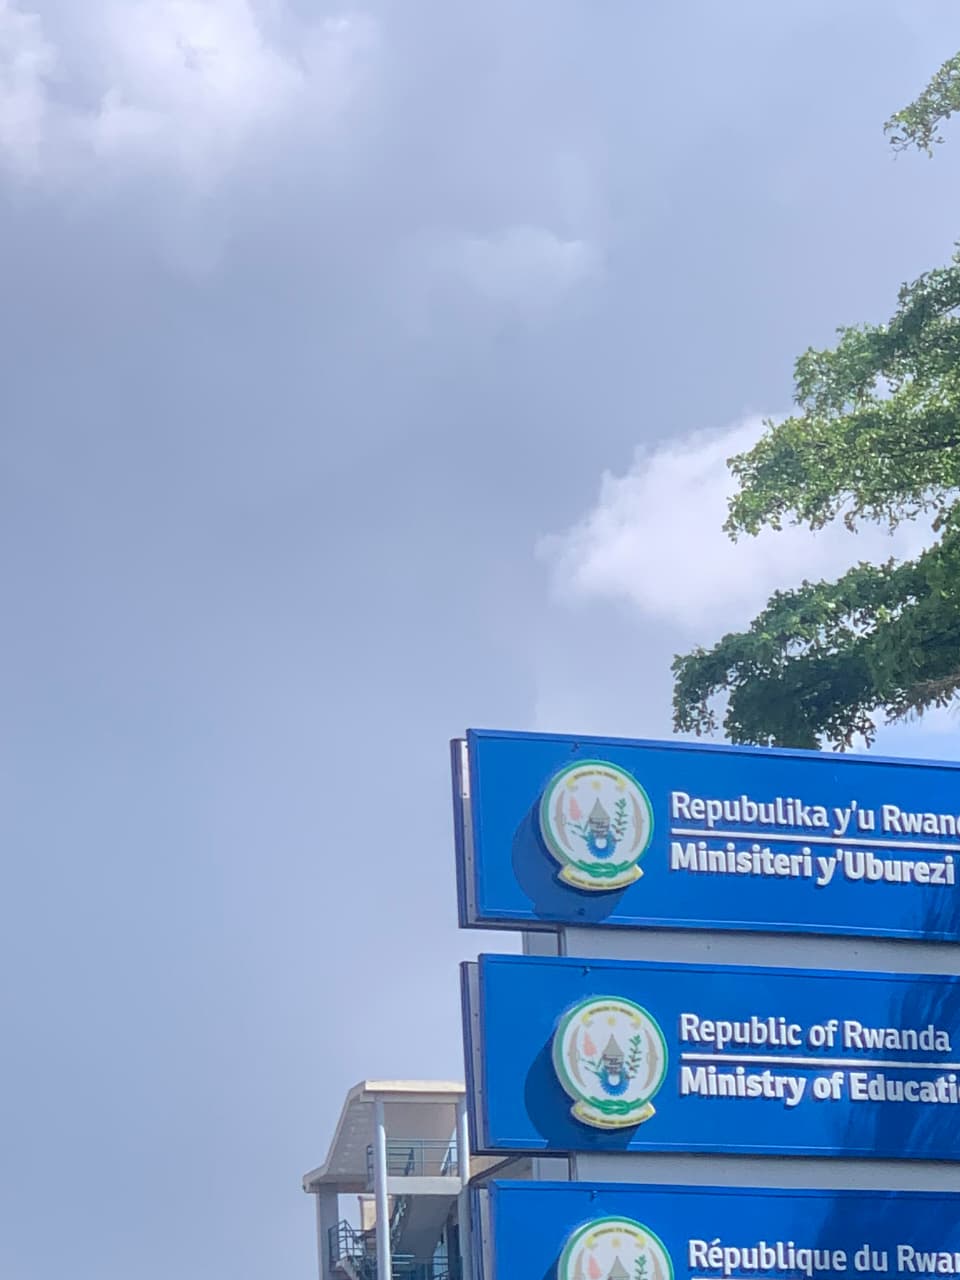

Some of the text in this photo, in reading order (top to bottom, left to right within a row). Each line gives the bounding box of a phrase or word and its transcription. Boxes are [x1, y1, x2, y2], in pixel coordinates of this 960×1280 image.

[671, 791, 829, 828] Repubulika
[833, 800, 875, 835] y'u
[671, 842, 955, 886] Minisiteri y'Uburezi
[680, 1013, 952, 1051] Republic of Rwanda
[681, 1065, 807, 1106] Ministry
[812, 1071, 844, 1100] of
[688, 1238, 847, 1277] République
[854, 1244, 888, 1272] du
